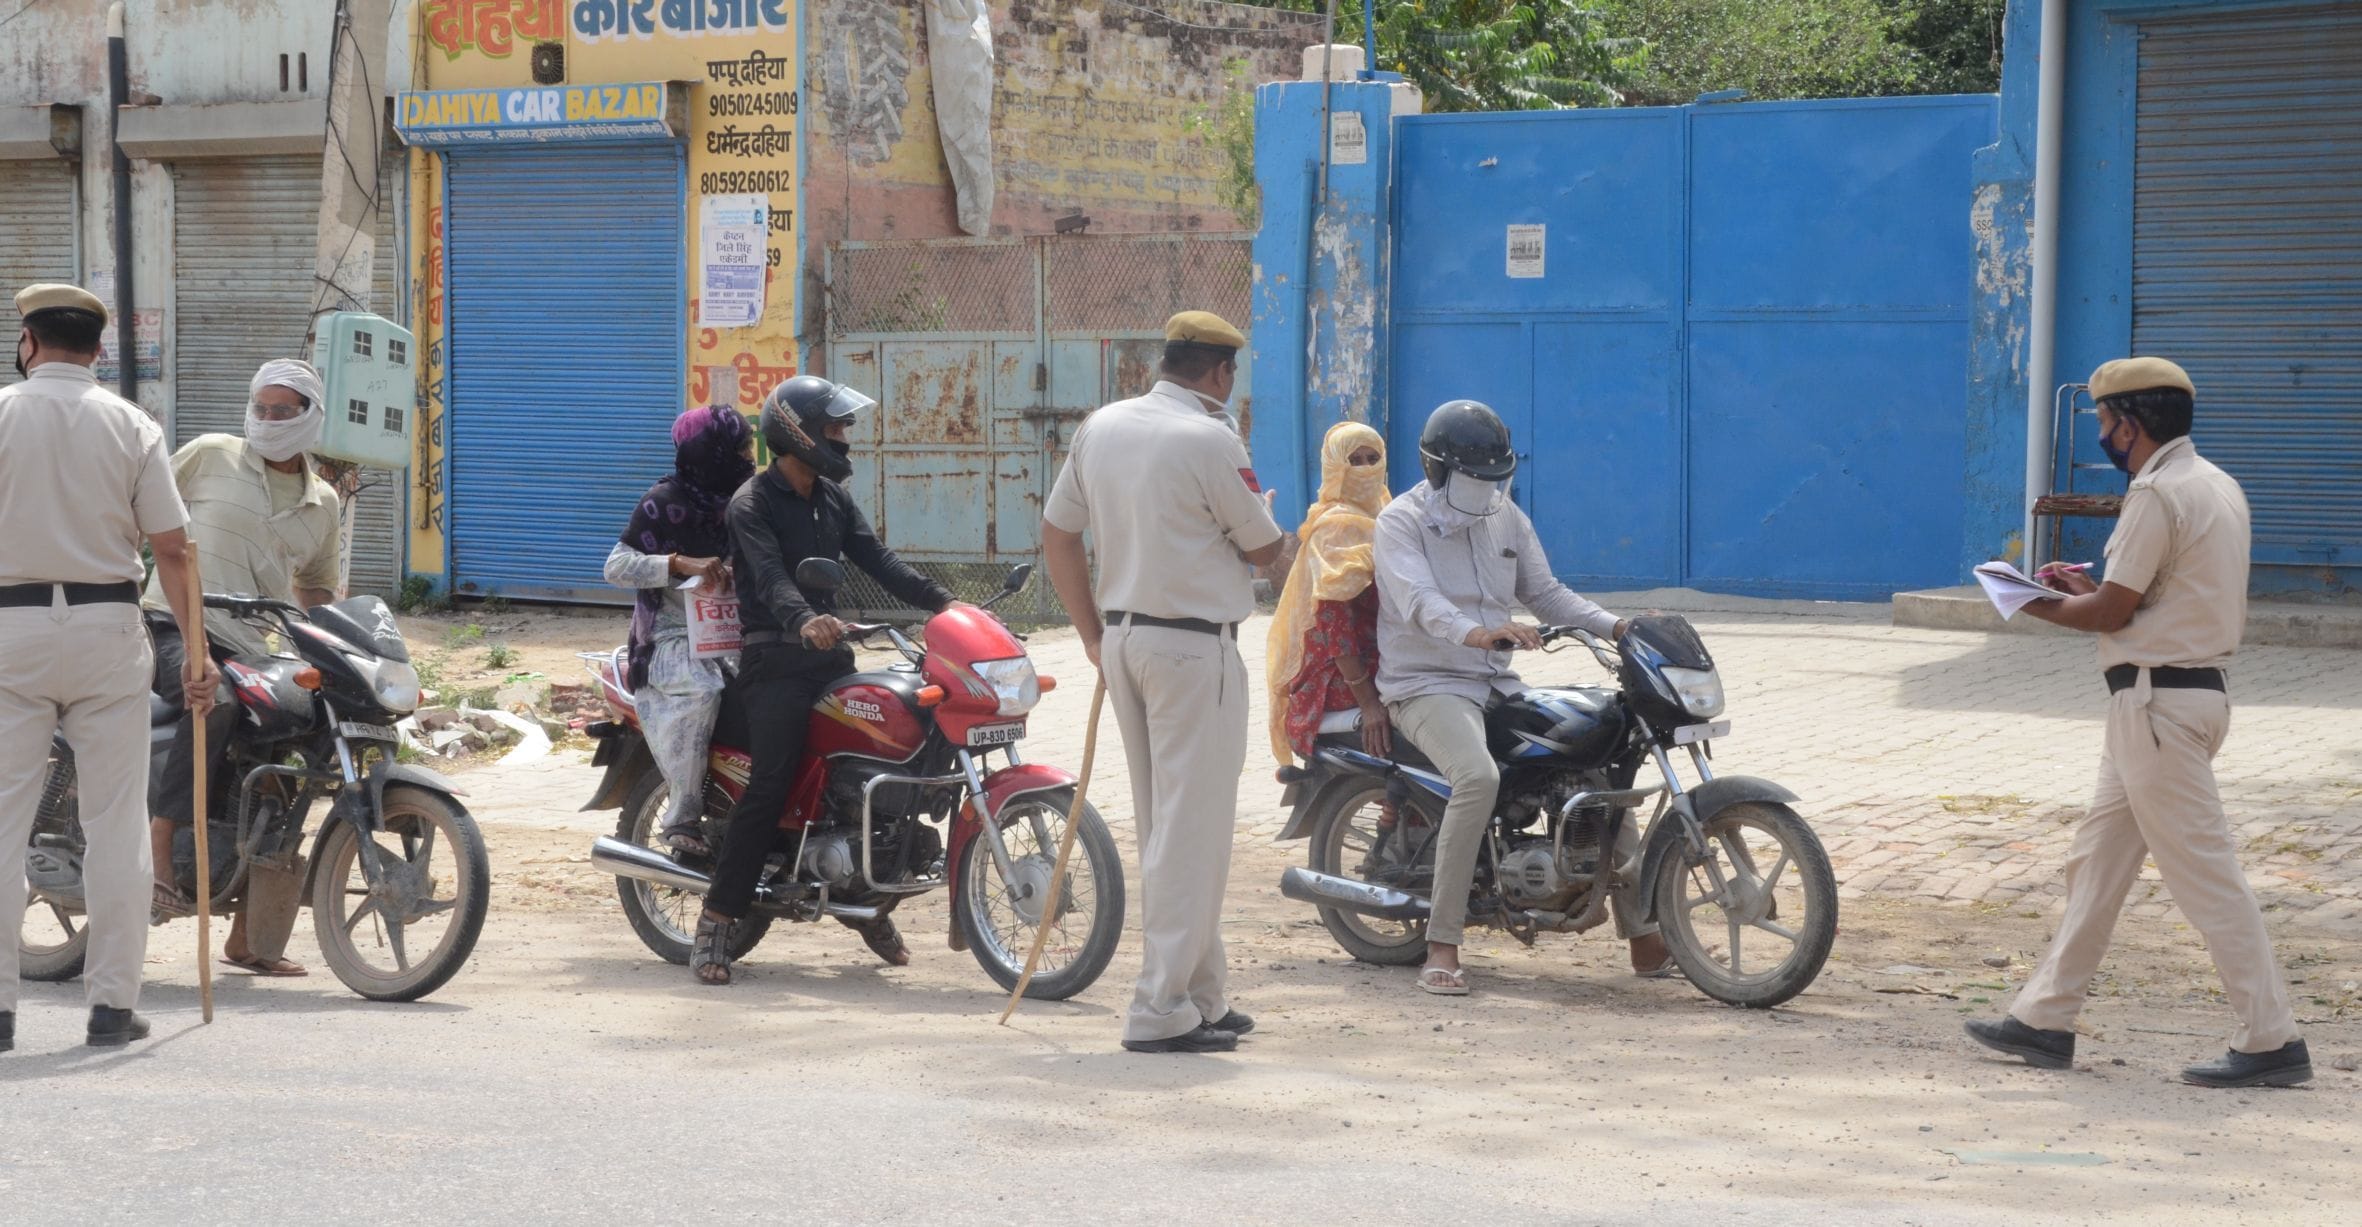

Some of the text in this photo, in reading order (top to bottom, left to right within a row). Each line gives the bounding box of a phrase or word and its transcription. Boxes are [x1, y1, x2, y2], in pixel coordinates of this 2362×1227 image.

[572, 0, 655, 42] कार
[661, 0, 788, 36] बाजार
[706, 49, 788, 87] पप्पू दहिया
[402, 85, 659, 127] DAHIYA CAR BAZAR
[709, 91, 798, 117] 9050245009
[751, 124, 792, 157] दहिया
[701, 170, 790, 194] 8059260612
[843, 706, 885, 722] HONDA
[847, 700, 880, 713] HERO
[973, 729, 1005, 745] UP-83D
